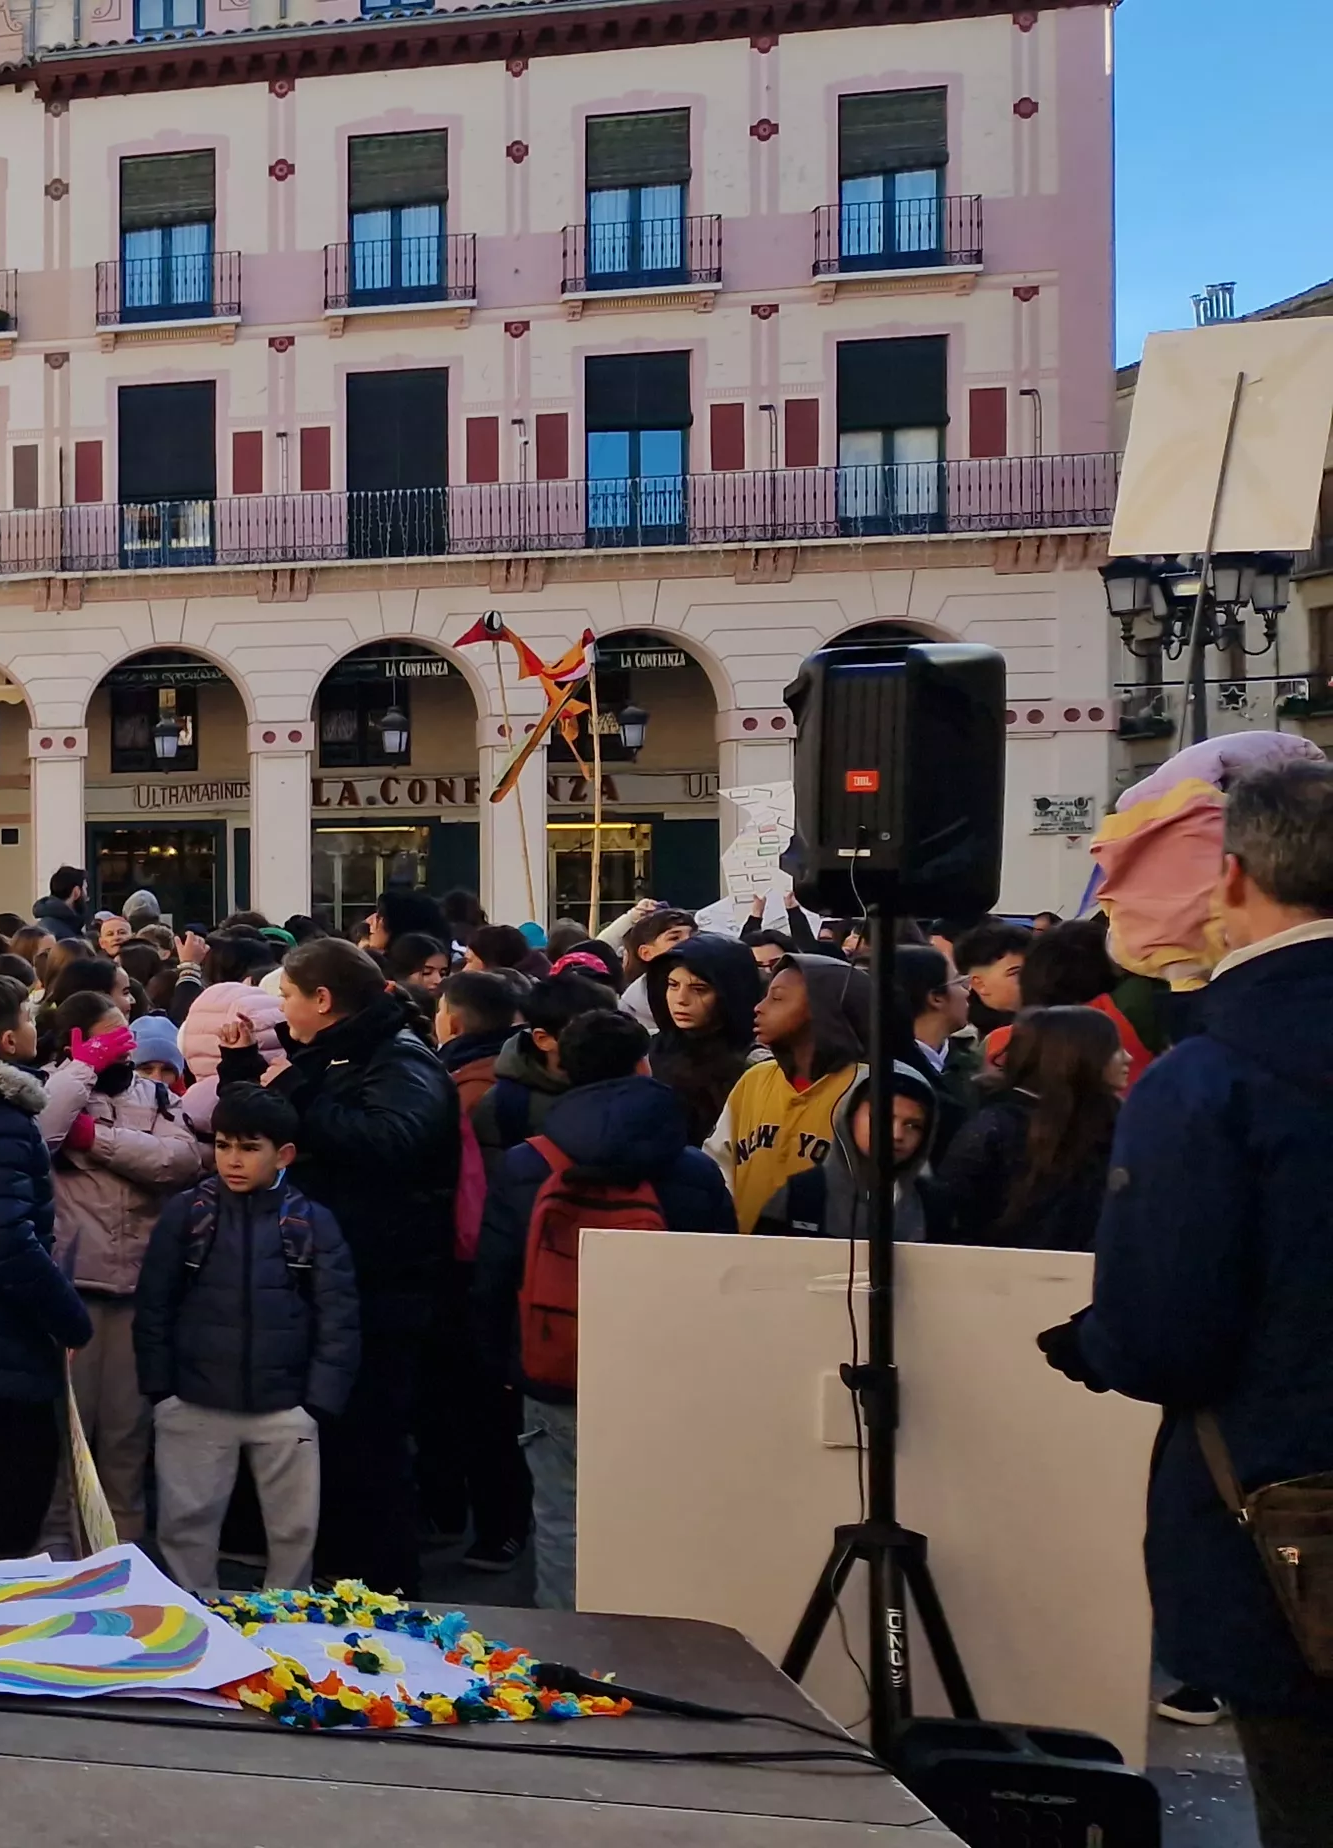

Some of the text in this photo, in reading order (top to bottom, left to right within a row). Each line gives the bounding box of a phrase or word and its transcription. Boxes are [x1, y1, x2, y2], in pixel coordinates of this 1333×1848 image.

[635, 652, 686, 668] CONFIANZA
[385, 662, 397, 677] LA
[399, 661, 449, 677] CONFIANZA
[853, 776, 873, 787] JBL
[136, 782, 251, 809] ULTRAMARINOS
[311, 777, 363, 806] LA
